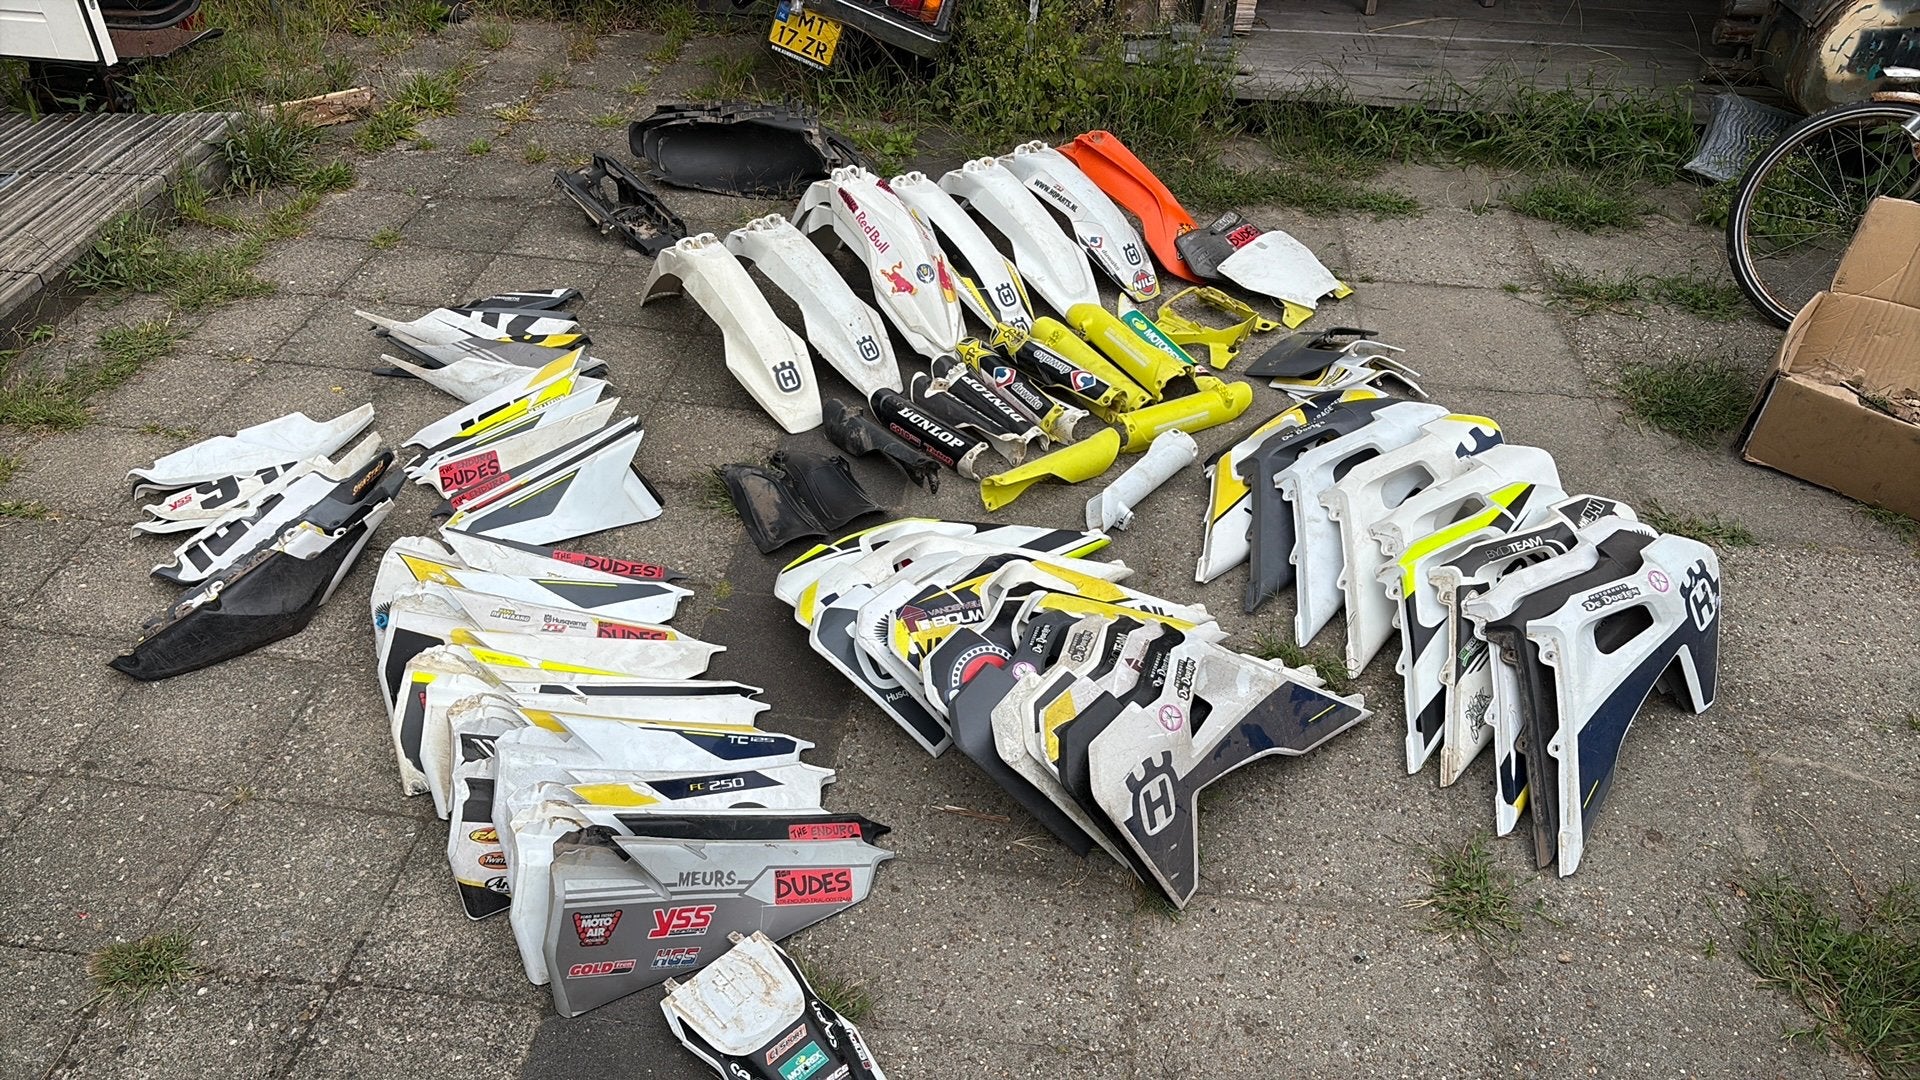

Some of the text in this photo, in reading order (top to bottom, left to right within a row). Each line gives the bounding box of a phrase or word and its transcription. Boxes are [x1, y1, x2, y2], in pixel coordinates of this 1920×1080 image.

[798, 10, 828, 36] MT
[778, 25, 828, 61] 17-ZR
[855, 211, 890, 254] Red Bull
[1133, 275, 1155, 292] NILS
[1033, 349, 1072, 374] duwako
[961, 376, 1027, 423] DUNLOP
[1011, 382, 1043, 410] duwako
[897, 406, 965, 448] DUNLOP
[440, 464, 453, 474] THE
[440, 459, 499, 490] DUDES
[554, 551, 571, 560] THE
[582, 556, 663, 577] DUDES!
[1584, 599, 1602, 612] De
[552, 617, 587, 627] Husqvarna
[932, 609, 985, 628] BOUW
[728, 735, 749, 745] TC
[689, 777, 745, 791] FC 250
[791, 825, 854, 838] THE ENDURO
[678, 870, 737, 887] MEURS
[776, 871, 851, 898] DUDES
[581, 917, 613, 928] MOTO
[648, 905, 716, 938] YSS
[586, 928, 606, 937] AIR
[653, 947, 701, 966] HGS
[569, 961, 614, 976] GOLD
[787, 1050, 822, 1080] MOTOREX
